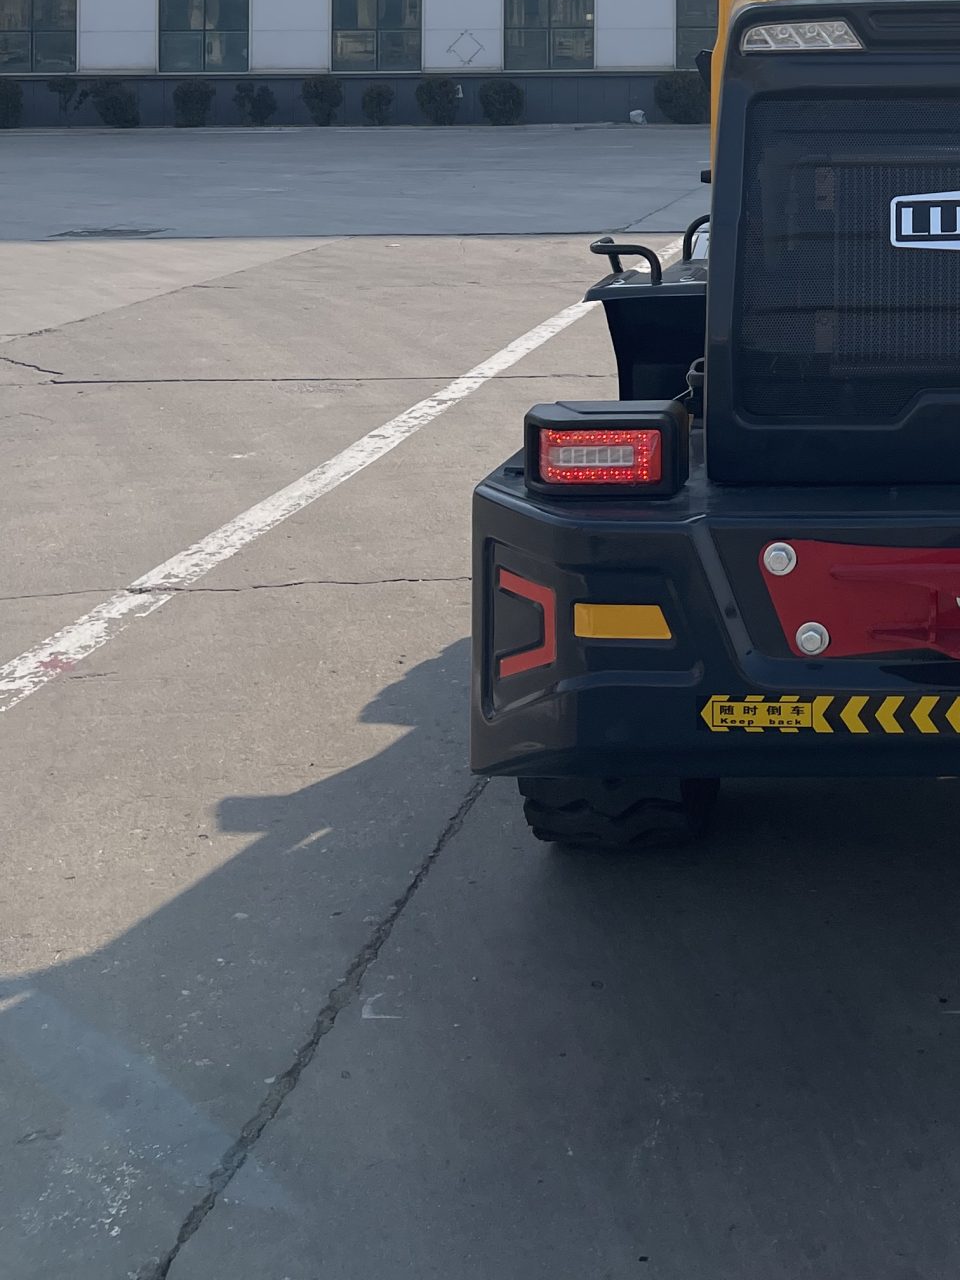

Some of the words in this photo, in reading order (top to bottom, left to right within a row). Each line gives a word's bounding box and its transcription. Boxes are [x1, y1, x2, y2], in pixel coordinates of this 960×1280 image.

[719, 705, 805, 716] 随时倒车
[720, 718, 754, 726] Keep
